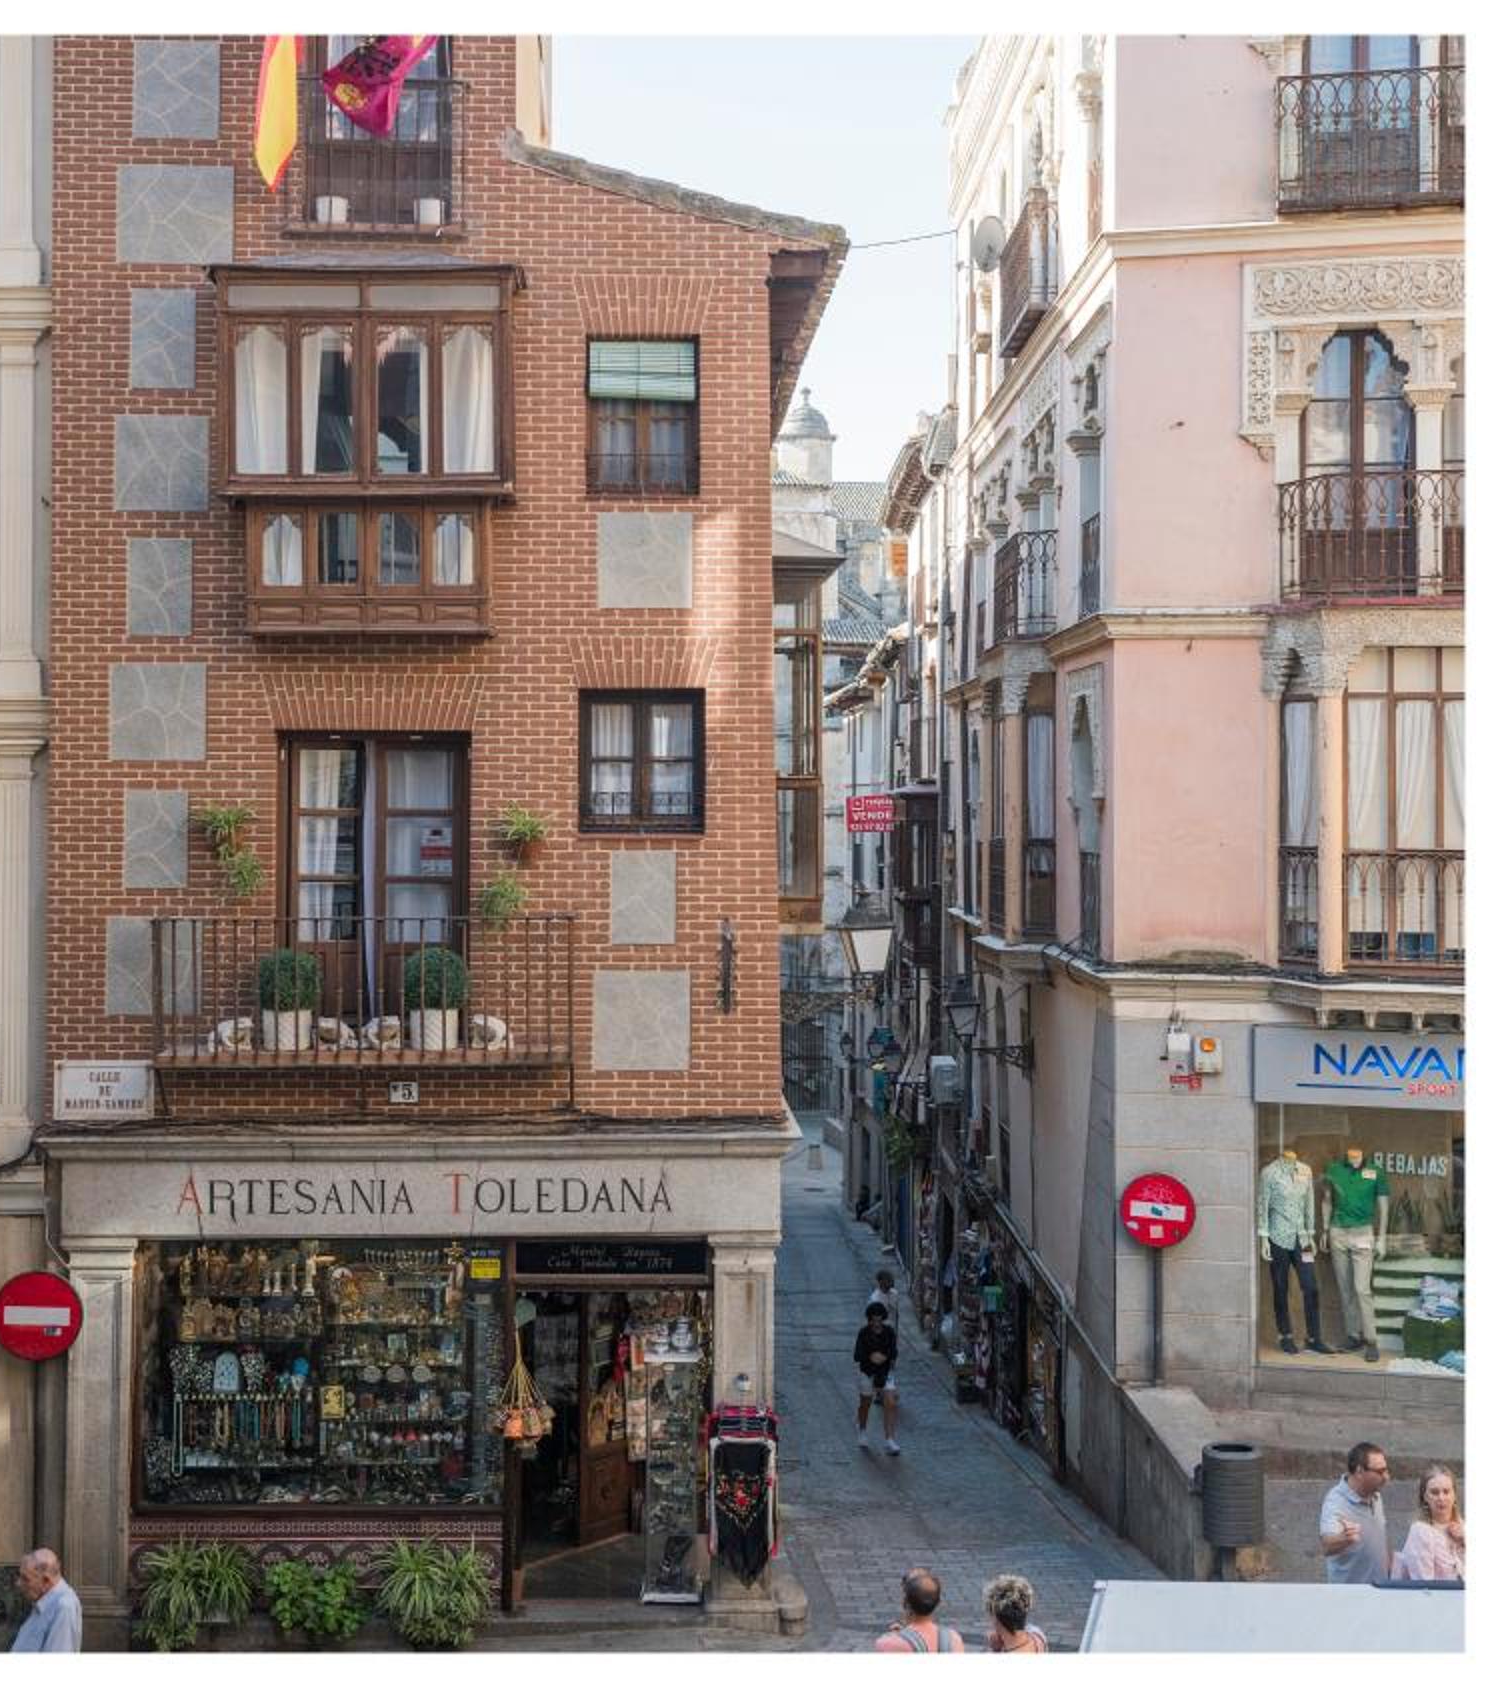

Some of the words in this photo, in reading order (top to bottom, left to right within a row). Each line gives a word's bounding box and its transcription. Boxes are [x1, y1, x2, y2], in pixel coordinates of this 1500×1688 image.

[851, 811, 893, 821] VENDE
[1313, 1043, 1466, 1081] NAVA
[89, 1071, 121, 1082] CALLE
[99, 1085, 112, 1096] DE
[1407, 1082, 1458, 1097] SPORT
[1373, 1151, 1448, 1177] REBAJAS
[176, 1171, 415, 1224] ARTESANIA
[442, 1171, 673, 1215] TOLEDANA
